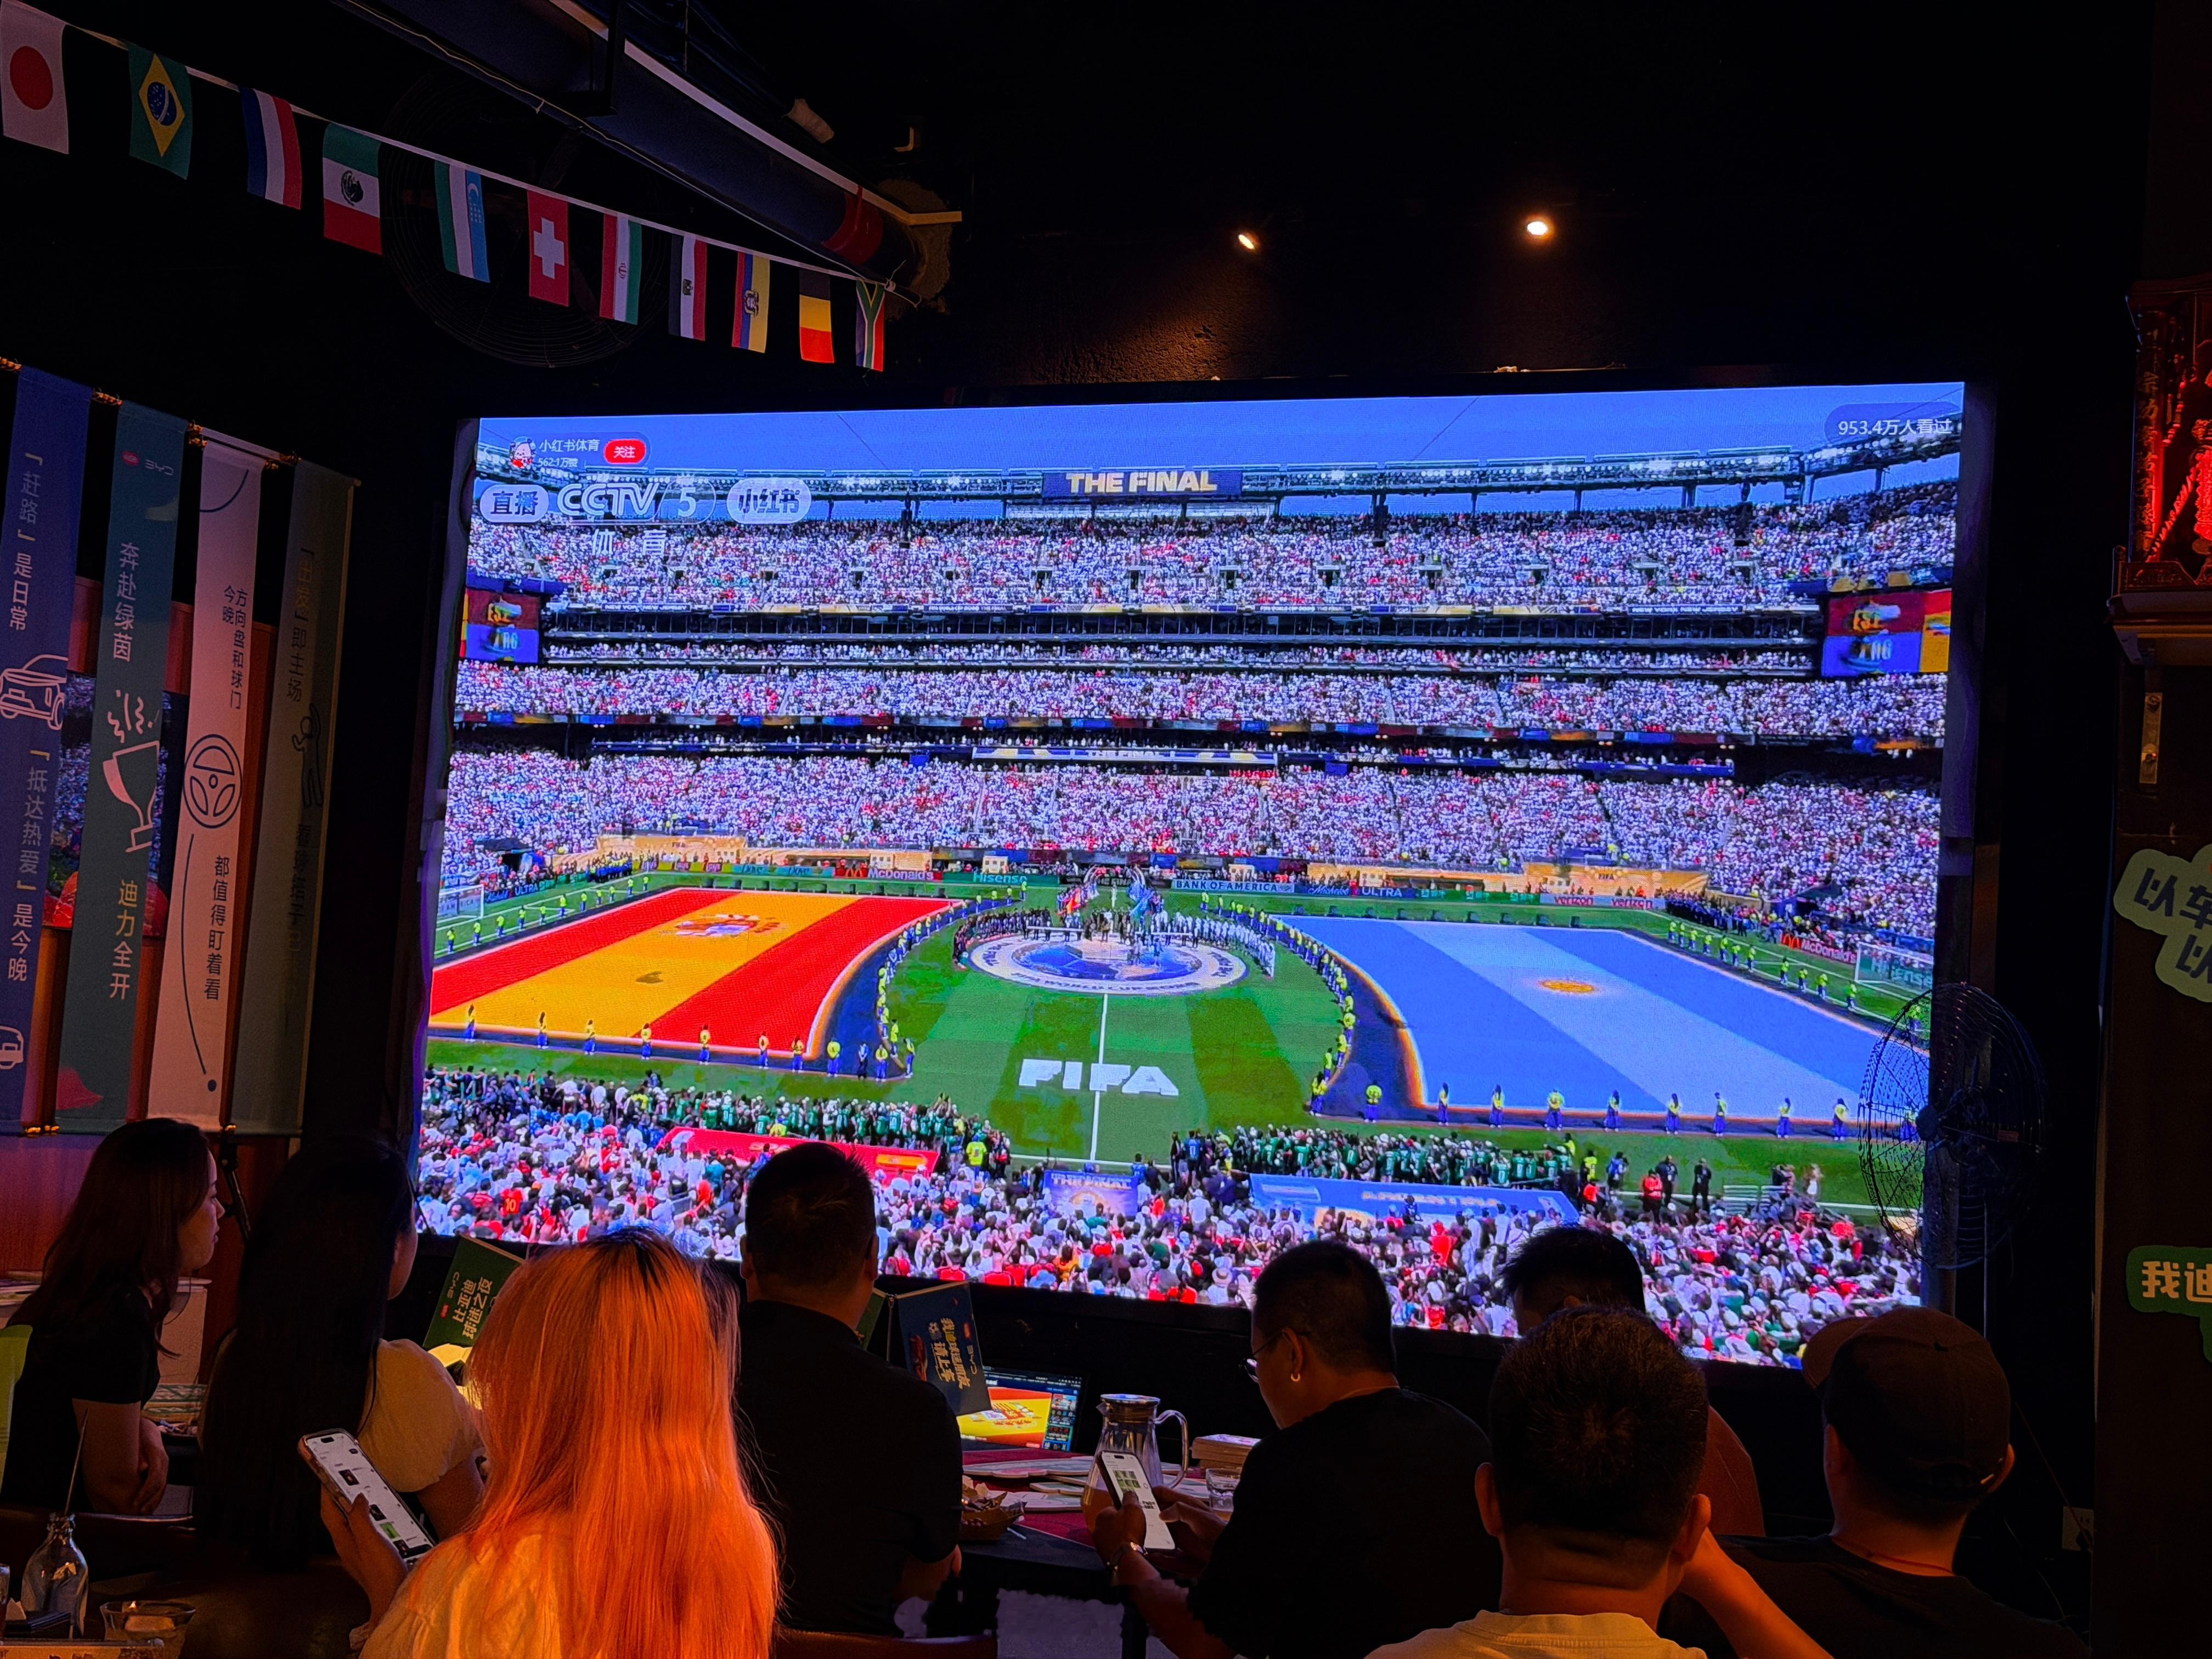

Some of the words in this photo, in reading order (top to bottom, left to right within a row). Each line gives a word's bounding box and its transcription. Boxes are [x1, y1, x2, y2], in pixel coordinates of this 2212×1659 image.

[1838, 419, 1952, 435] 953.4万人看过
[539, 439, 600, 452] 小红书体育
[613, 445, 636, 458] 关注
[145, 459, 174, 476] BYD
[1065, 472, 1124, 493] THE
[1128, 470, 1217, 492] FINAL
[490, 490, 538, 516] 直播
[557, 483, 659, 517] CCTV
[678, 487, 697, 517] 5
[738, 488, 800, 514] 小红书
[593, 528, 668, 555] 体育
[113, 542, 140, 663] 奔赴绿茵
[867, 868, 934, 881] McDonald's
[1176, 881, 1206, 889] BANK
[1210, 881, 1224, 890] OF
[1226, 882, 1277, 891] AMERICA
[515, 885, 538, 896] ULTRA
[1362, 885, 1403, 898] ULTRA
[1554, 895, 1594, 906] verizon
[110, 879, 138, 1000] 迪力全开
[204, 855, 229, 1001] 都值得盯着看
[1801, 939, 1857, 964] McDonald's
[1018, 1059, 1179, 1096] FIFA
[453, 1279, 476, 1323] 比亚迪
[462, 1277, 493, 1340] 球迷之夜
